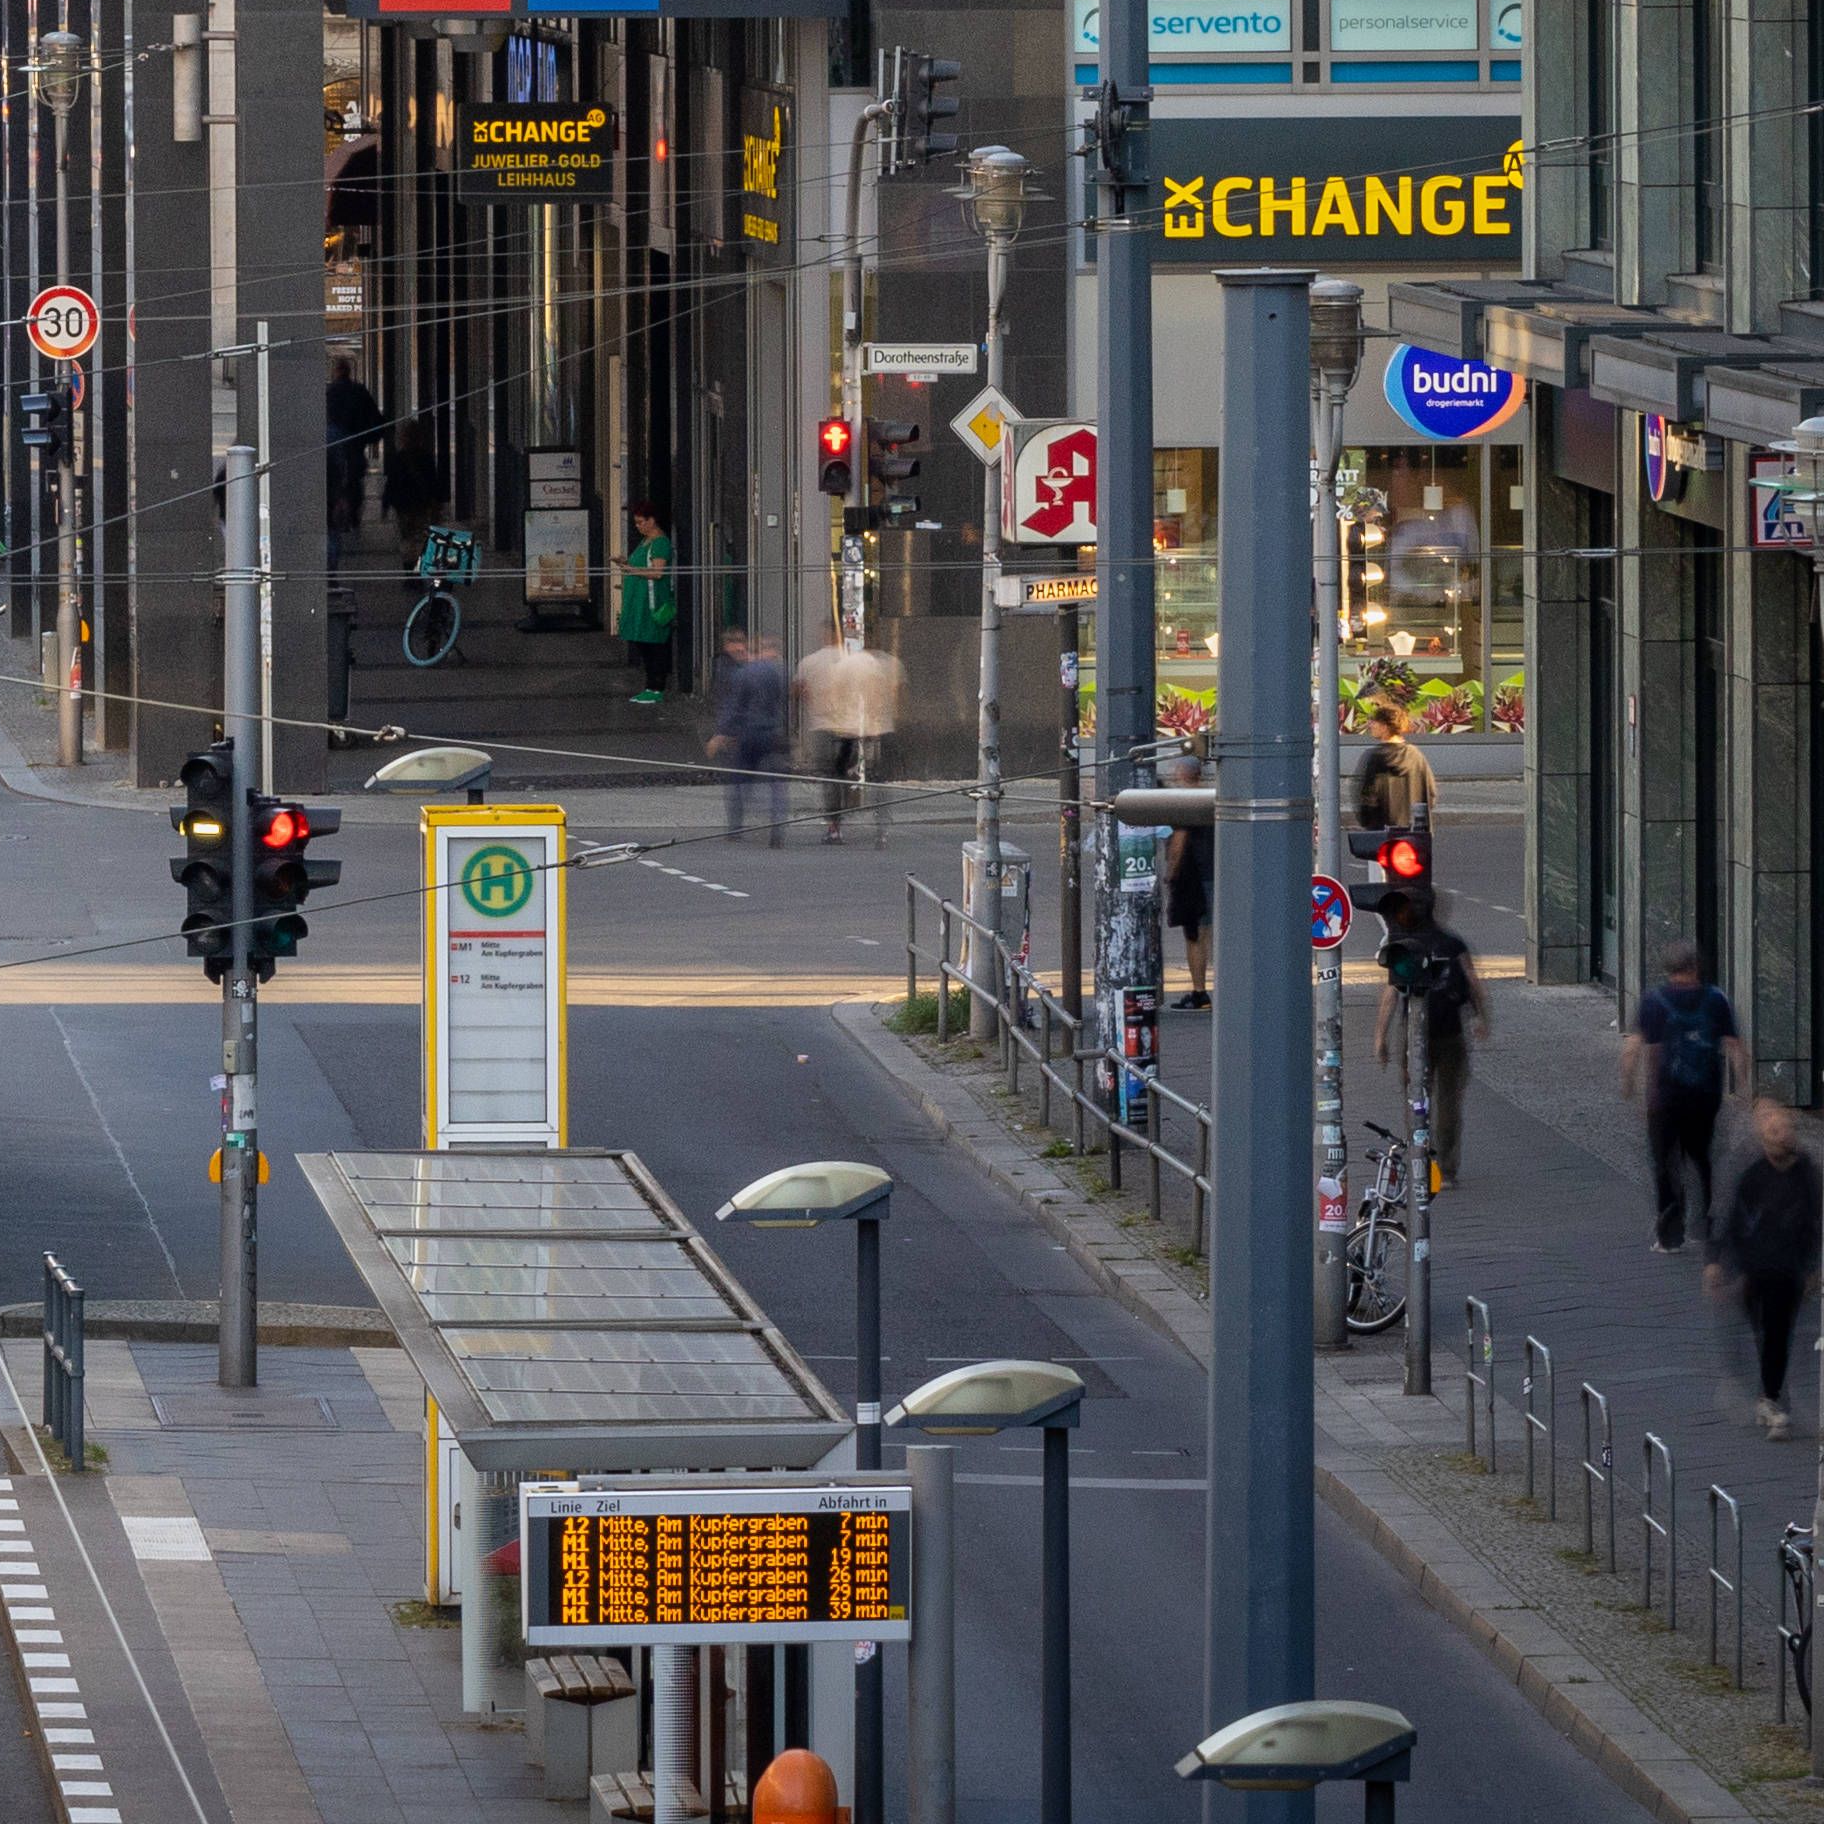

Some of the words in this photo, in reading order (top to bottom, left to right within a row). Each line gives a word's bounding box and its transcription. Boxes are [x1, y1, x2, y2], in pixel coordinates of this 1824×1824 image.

[1152, 11, 1281, 34] servento
[1339, 14, 1469, 32] personalservice
[497, 173, 576, 187] LEIHHAUS
[43, 307, 84, 338] 30
[874, 350, 969, 367] Dorotheenstraße
[1413, 363, 1498, 393] budni
[1426, 398, 1484, 409] drogeriemarkt
[458, 943, 472, 951] M1
[494, 950, 543, 959] Kupfergraben
[459, 975, 471, 984] 12
[494, 983, 543, 992] Kupfergraben
[551, 1500, 582, 1513] Linie
[597, 1500, 621, 1513] Ziel
[818, 1496, 871, 1510] Abfahrt
[874, 1495, 887, 1508] in
[564, 1518, 589, 1534] 12
[599, 1517, 649, 1536] Mitte,
[657, 1516, 682, 1533] Am
[690, 1515, 808, 1534] Kupfergraben
[840, 1513, 850, 1529] 7
[856, 1513, 888, 1530] min
[562, 1536, 589, 1552] M1
[599, 1535, 649, 1554] Mitte,
[657, 1534, 682, 1551] Am
[690, 1533, 808, 1552] Kupfergraben
[840, 1531, 850, 1547] 7
[856, 1531, 888, 1548] min
[562, 1554, 589, 1570] M1
[599, 1553, 649, 1572] Mitte,
[657, 1552, 682, 1569] Am
[690, 1551, 808, 1570] Kupfergraben
[830, 1549, 850, 1565] 19
[856, 1549, 888, 1566] min
[564, 1572, 589, 1588] 12
[599, 1571, 649, 1590] Mitte,
[657, 1570, 682, 1587] Am
[690, 1569, 808, 1588] Kupfergraben
[830, 1567, 850, 1583] 26
[856, 1567, 888, 1584] min
[562, 1590, 589, 1606] M1
[599, 1589, 649, 1608] Mitte,
[657, 1588, 682, 1605] Am
[690, 1587, 808, 1606] Kupfergraben
[830, 1585, 850, 1601] 29
[856, 1585, 888, 1602] min
[562, 1607, 589, 1624] M1
[599, 1606, 649, 1624] Mitte,
[657, 1605, 682, 1622] Am
[690, 1604, 808, 1623] Kupfergraben
[830, 1603, 850, 1619] 39
[856, 1603, 888, 1620] min
